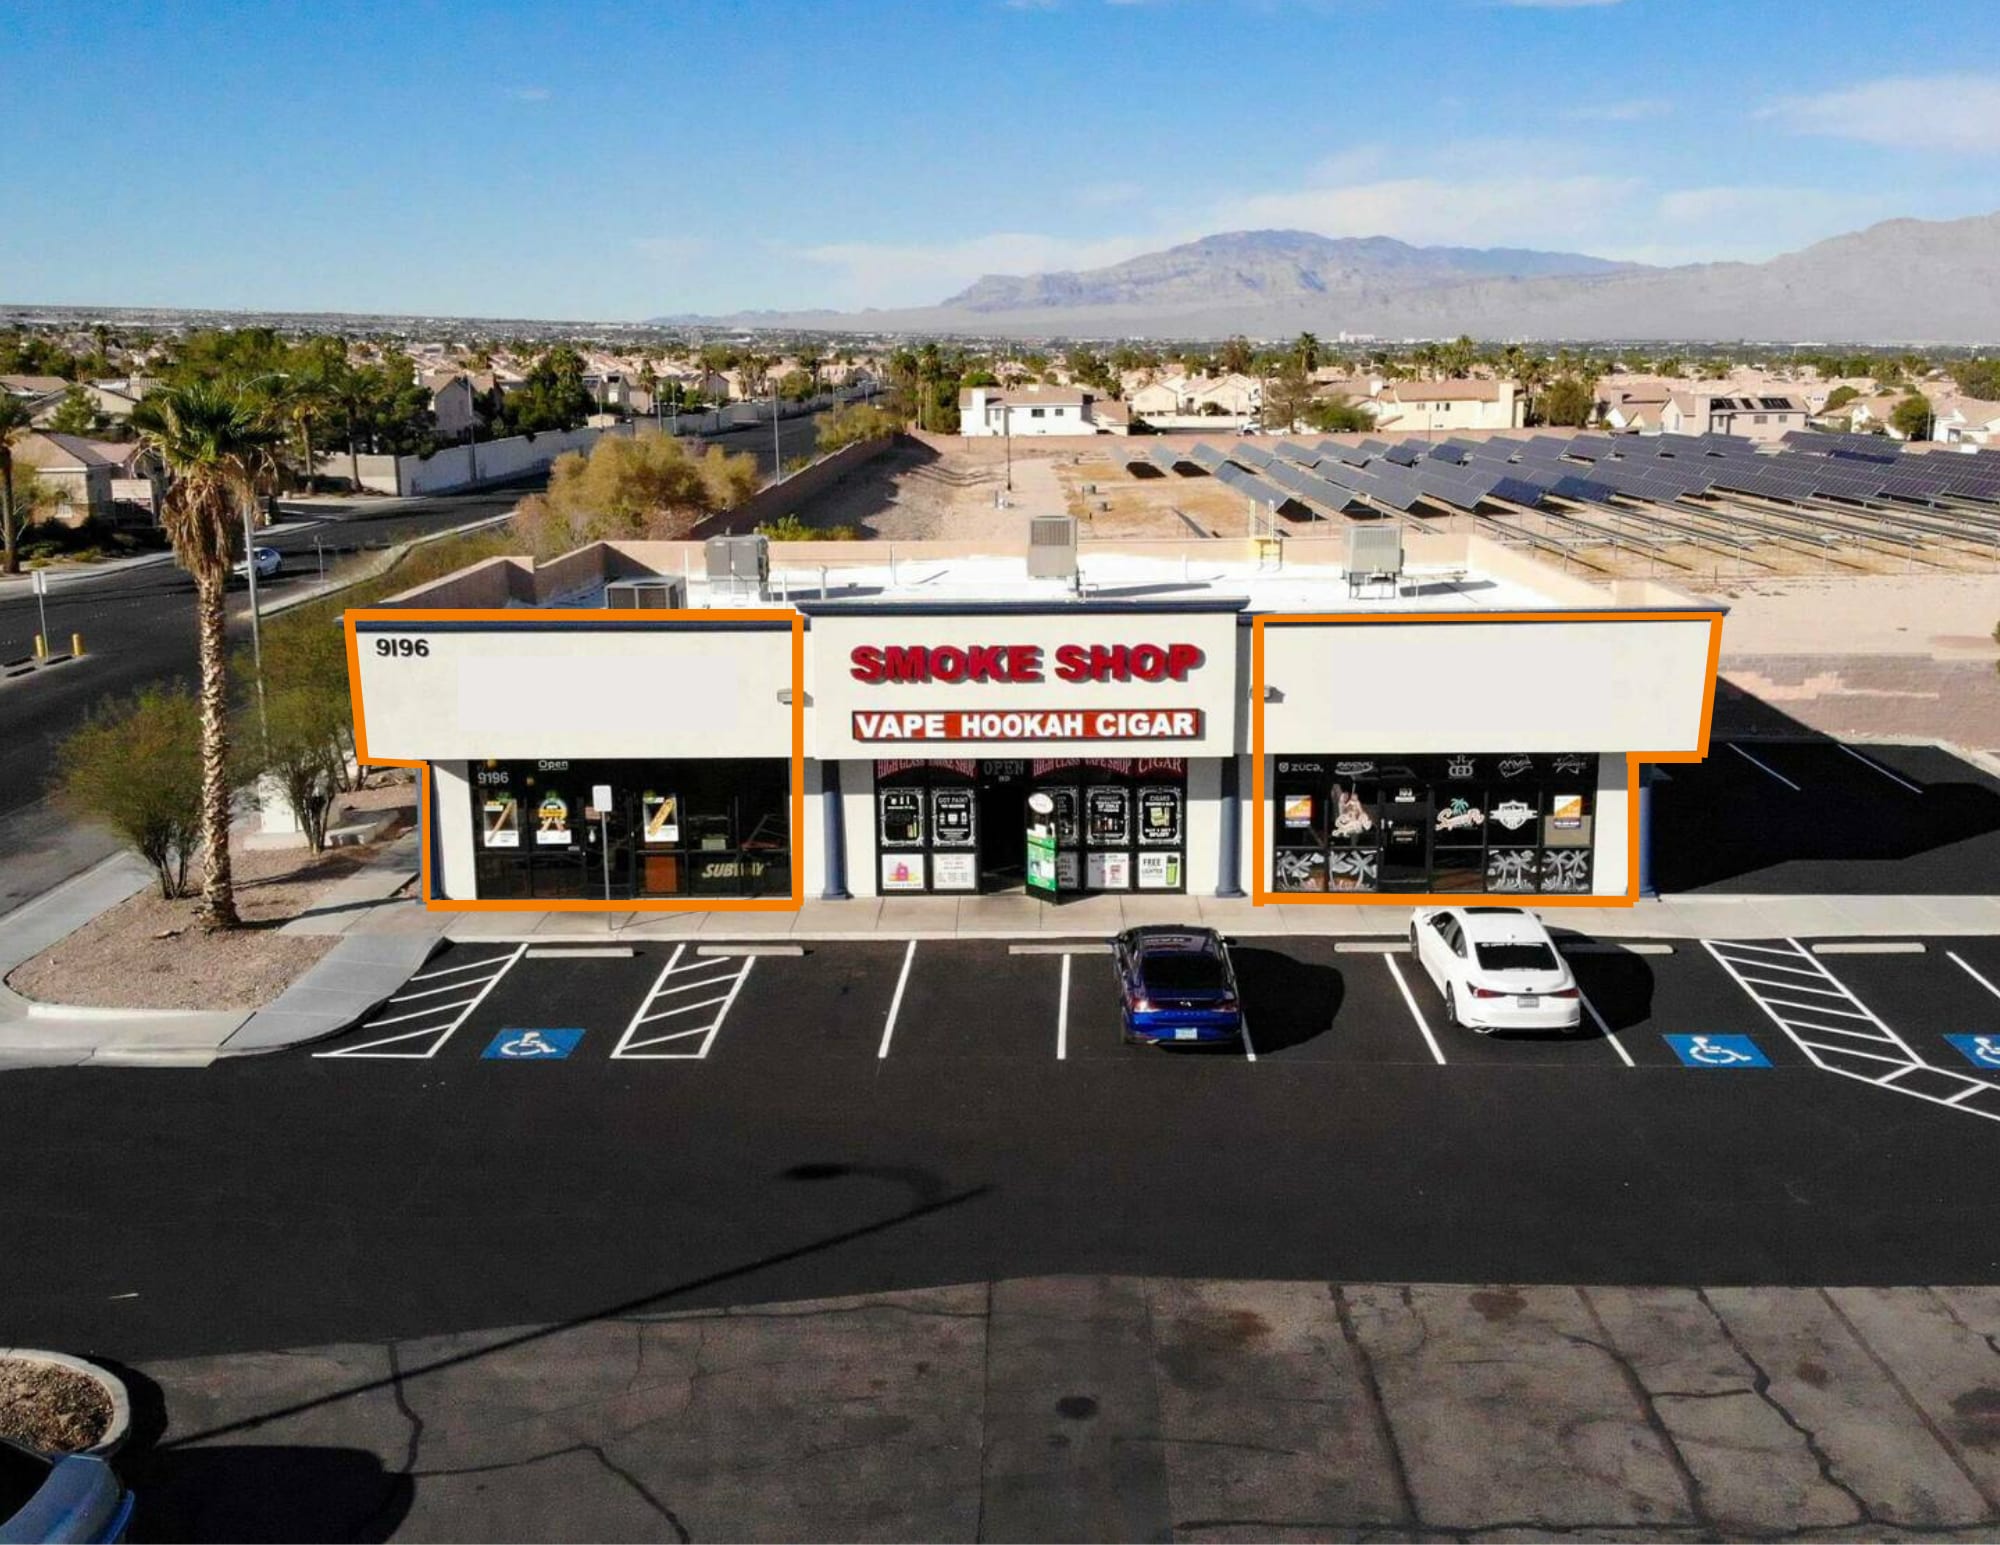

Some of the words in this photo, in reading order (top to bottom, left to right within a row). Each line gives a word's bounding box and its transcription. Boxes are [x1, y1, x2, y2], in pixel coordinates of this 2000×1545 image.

[375, 638, 430, 658] 9196
[850, 644, 1042, 683] SMOKE
[1055, 643, 1204, 682] SHOP
[855, 713, 946, 738] VAPE
[961, 713, 1083, 737] HOOKAH
[1095, 712, 1196, 737] CIGAR
[538, 759, 569, 771] Open
[477, 772, 509, 785] 9196
[1143, 858, 1161, 867] FREE
